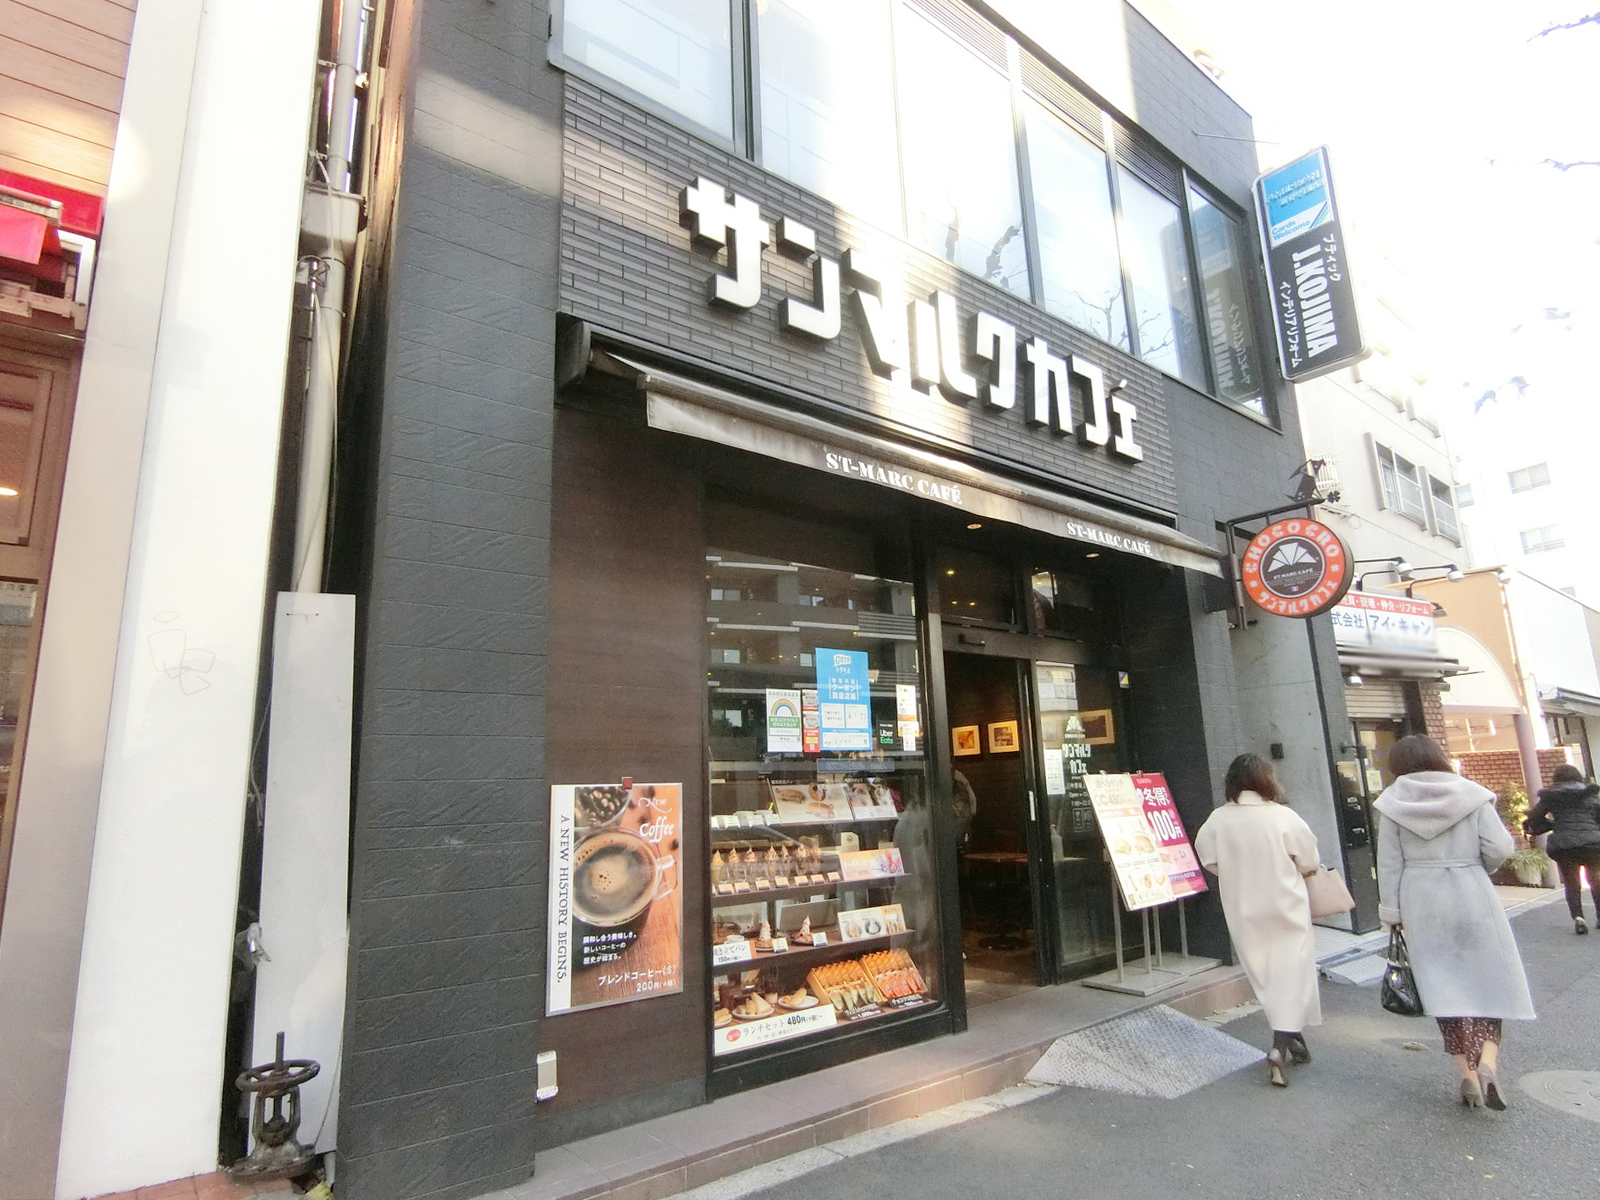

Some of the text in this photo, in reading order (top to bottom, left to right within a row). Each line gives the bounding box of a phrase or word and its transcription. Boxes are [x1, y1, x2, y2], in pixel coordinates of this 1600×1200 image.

[1272, 221, 1296, 235] Cards
[1273, 220, 1311, 241] Welcome
[1323, 233, 1341, 282] ブティック
[681, 176, 1143, 463] サンマルクカフェ
[1292, 244, 1338, 358] J.KOJIMA
[826, 452, 962, 505] ST-MARC CAFÉ
[1066, 520, 1154, 557] ST-MARC CAFÉ
[880, 729, 893, 737] Uber
[640, 816, 675, 843] Coffee
[556, 814, 570, 983] A NEW HISTORY BEGINS.
